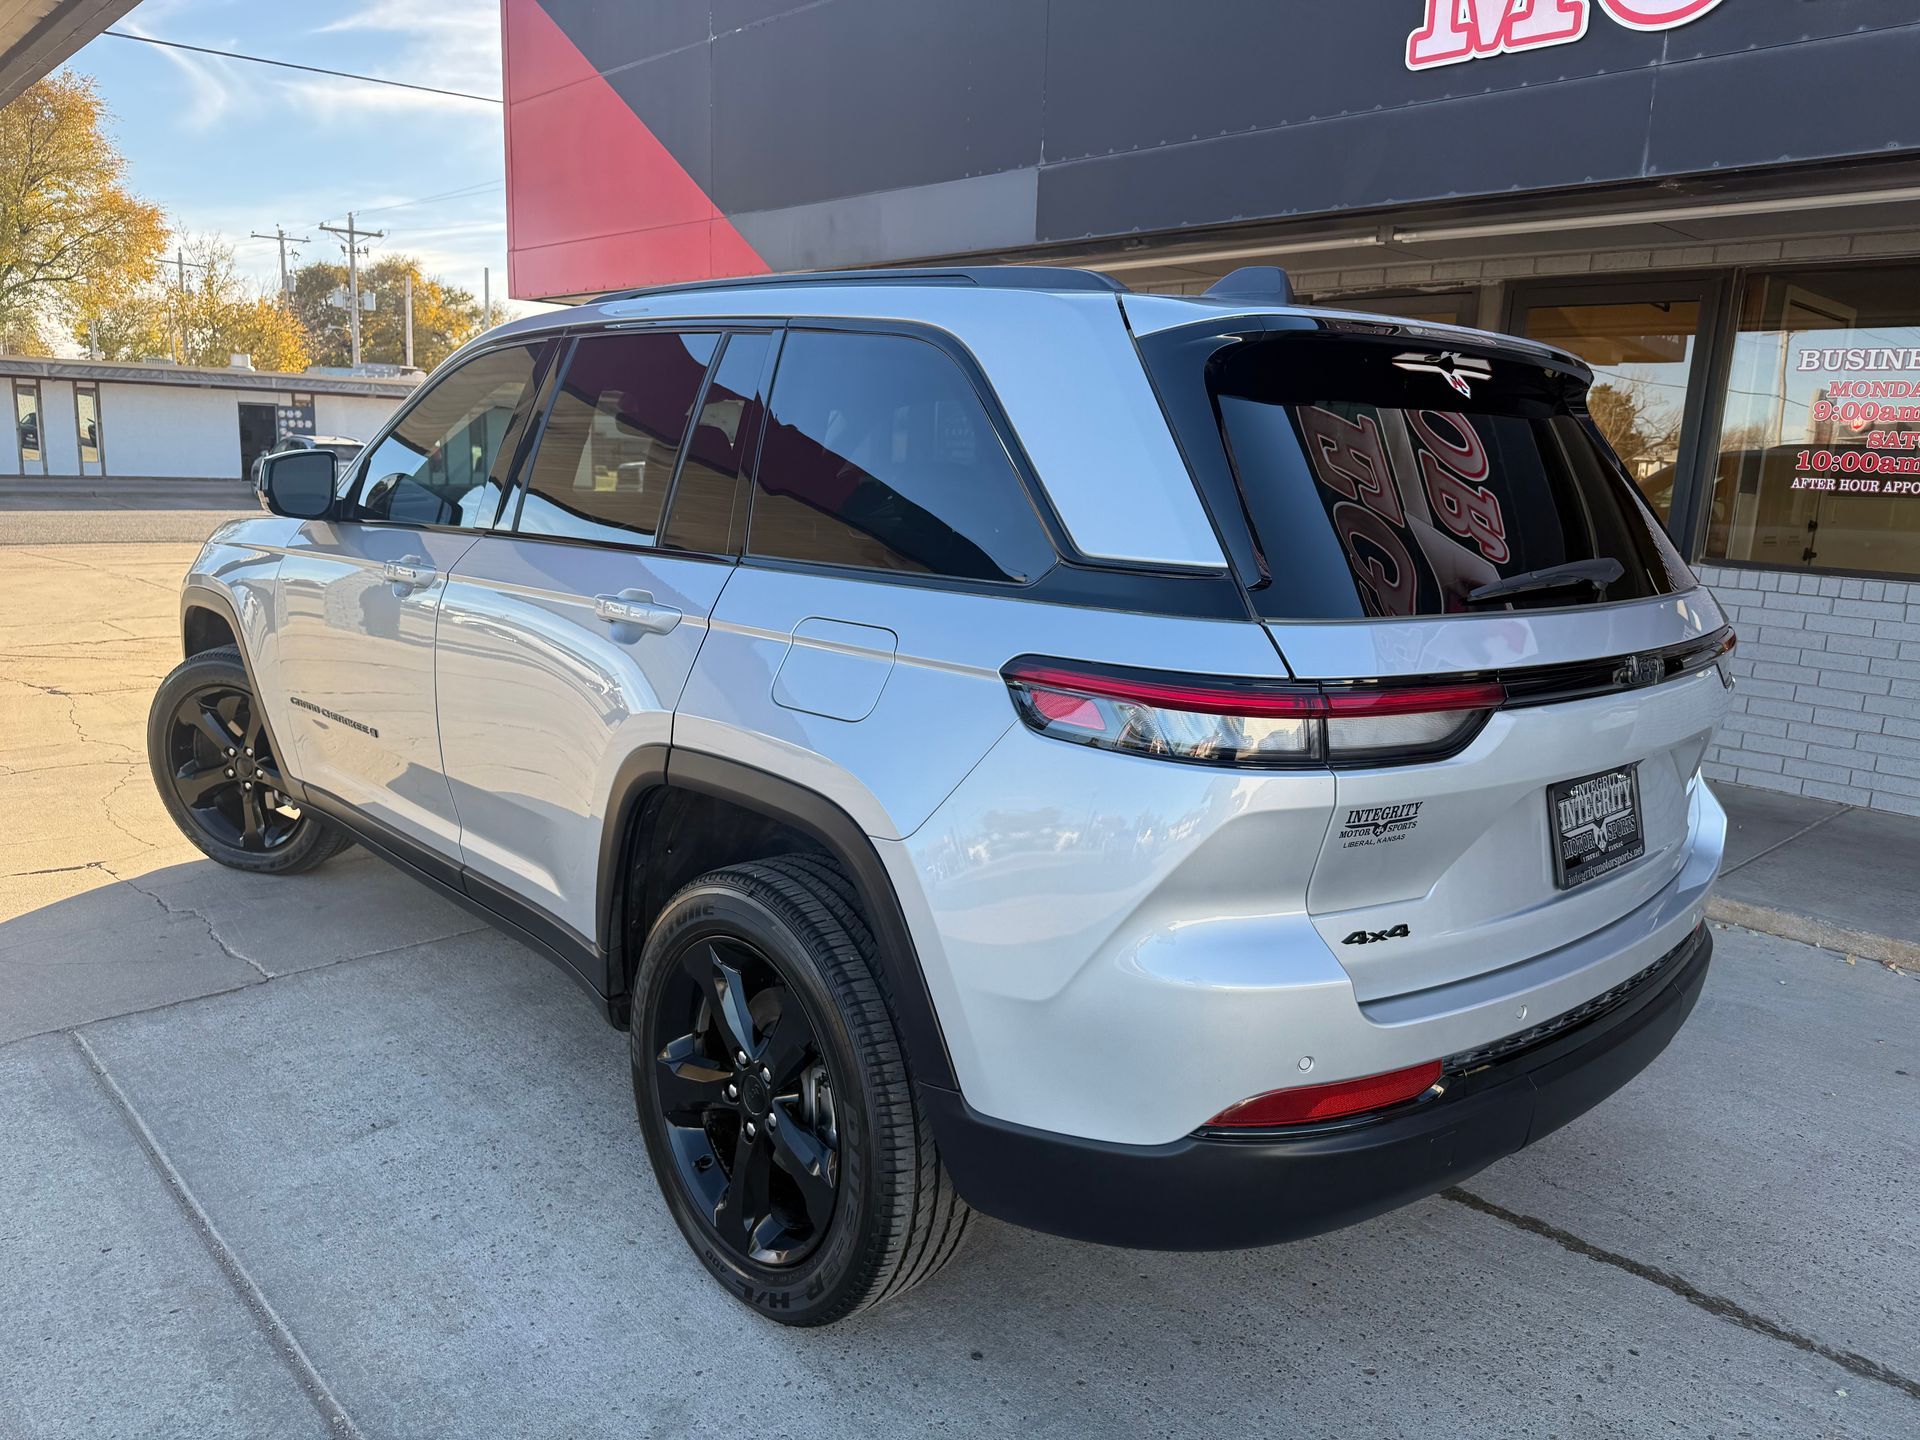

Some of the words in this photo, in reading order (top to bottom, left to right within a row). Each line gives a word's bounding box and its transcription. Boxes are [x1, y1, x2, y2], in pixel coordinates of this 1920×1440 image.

[1795, 450, 1920, 474] 10:00am
[1791, 477, 1836, 490] AFTER
[1839, 478, 1879, 492] HOUR
[1346, 801, 1423, 825] INTEGRITY
[1558, 777, 1632, 834] INTEGRITY
[1339, 828, 1371, 839] MOTOR
[1387, 820, 1418, 833] SPORTS
[1376, 833, 1406, 845] KANSAS
[1562, 830, 1597, 860] MOTOR
[1606, 815, 1637, 842] SPORTS
[1341, 923, 1411, 945] 4x4
